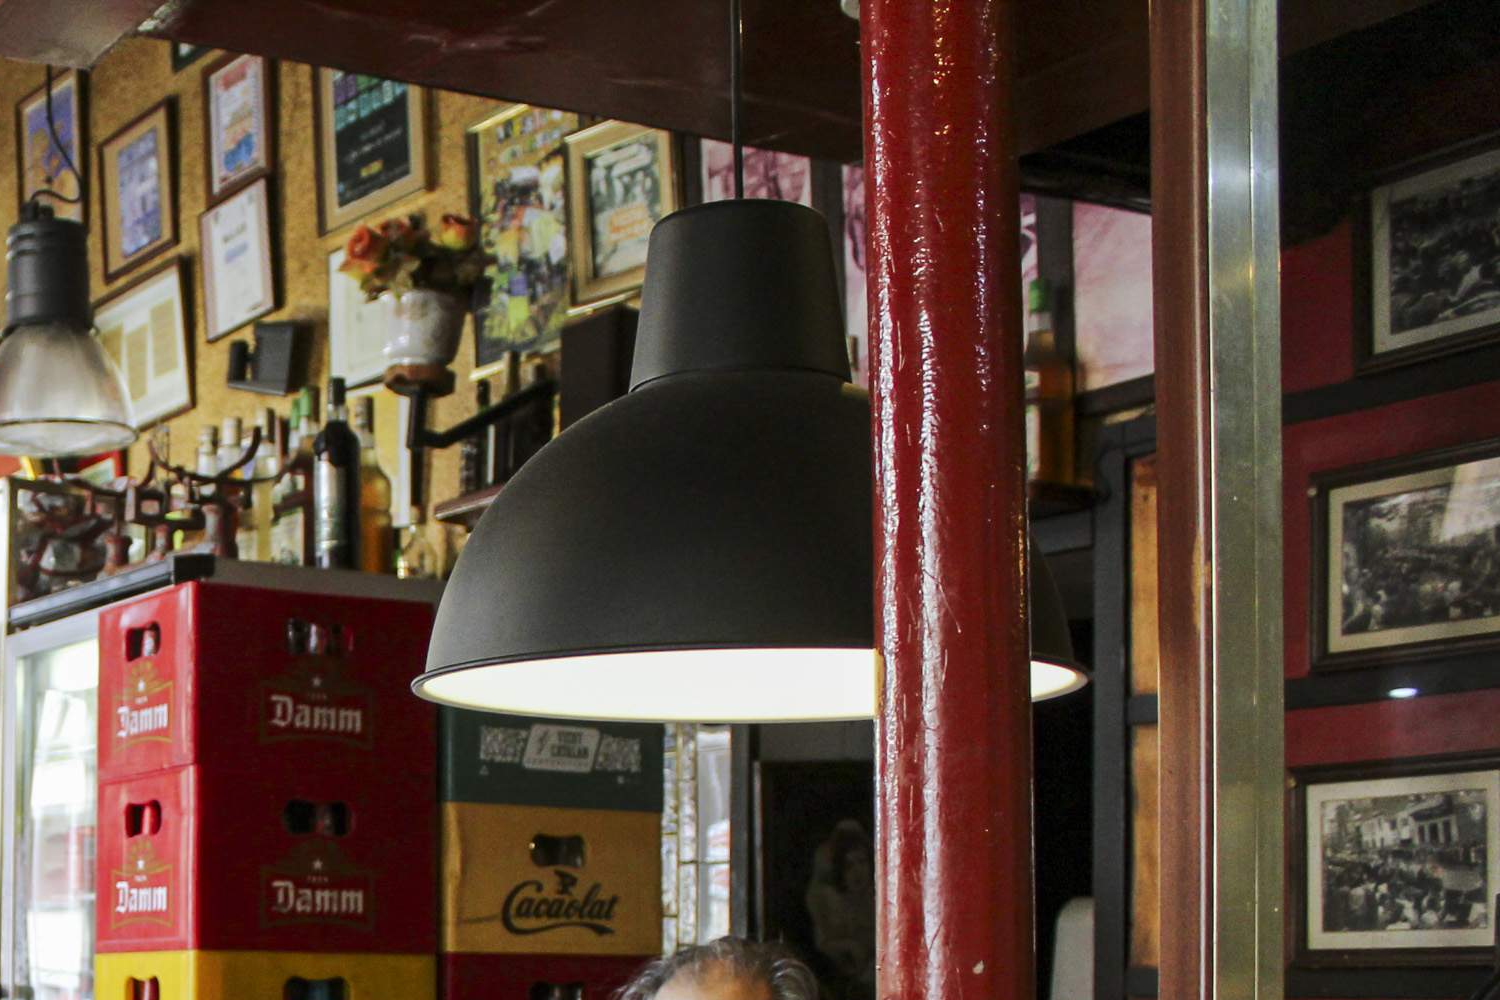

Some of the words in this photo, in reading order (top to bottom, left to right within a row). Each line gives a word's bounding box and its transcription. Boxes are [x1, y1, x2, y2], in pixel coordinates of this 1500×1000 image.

[116, 703, 169, 737] Damm
[270, 694, 363, 734] Damm
[115, 881, 168, 914] Damm
[271, 881, 365, 915] Damm
[501, 879, 620, 936] Cacaolat
